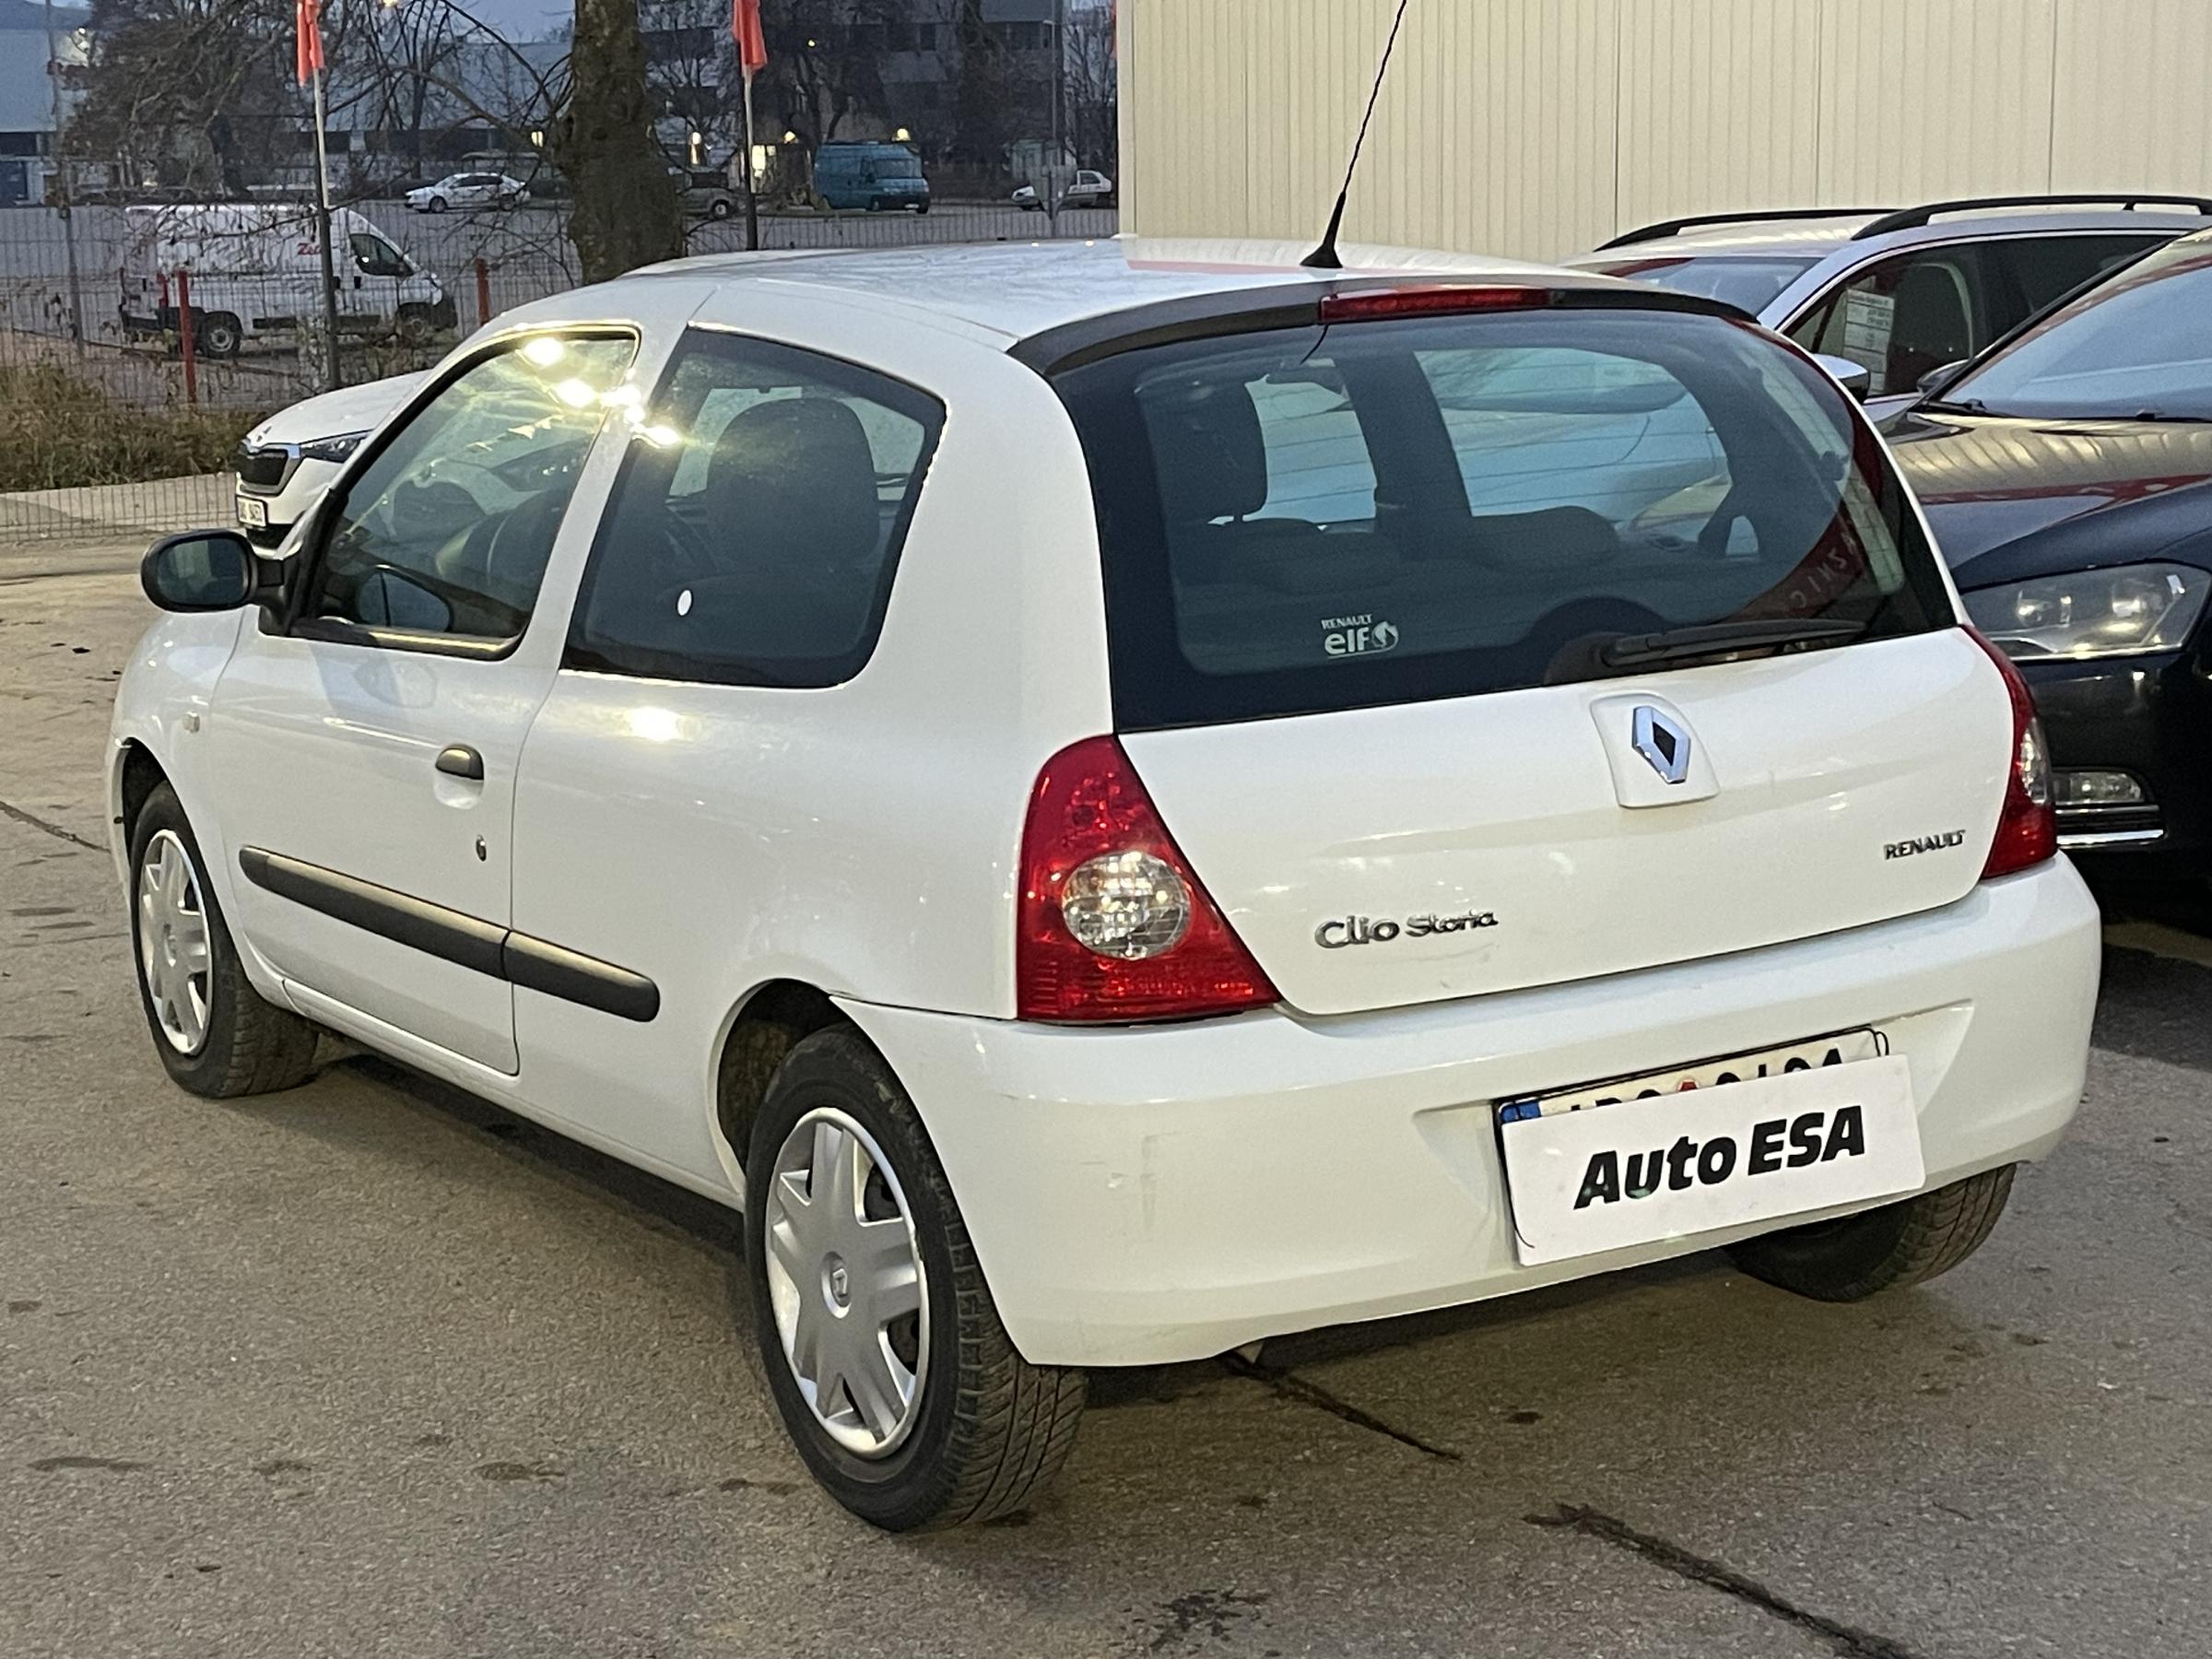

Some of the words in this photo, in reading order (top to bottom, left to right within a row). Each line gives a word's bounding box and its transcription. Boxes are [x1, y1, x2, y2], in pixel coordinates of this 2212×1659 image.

[1321, 613, 1372, 629] RENAULT
[1324, 627, 1370, 654] elf
[1883, 829, 1966, 861] RENAULT
[1314, 915, 1401, 949] Clio
[1405, 908, 1500, 937] Storia
[1573, 1135, 1737, 1210] Auto
[1747, 1105, 1865, 1176] ESA
